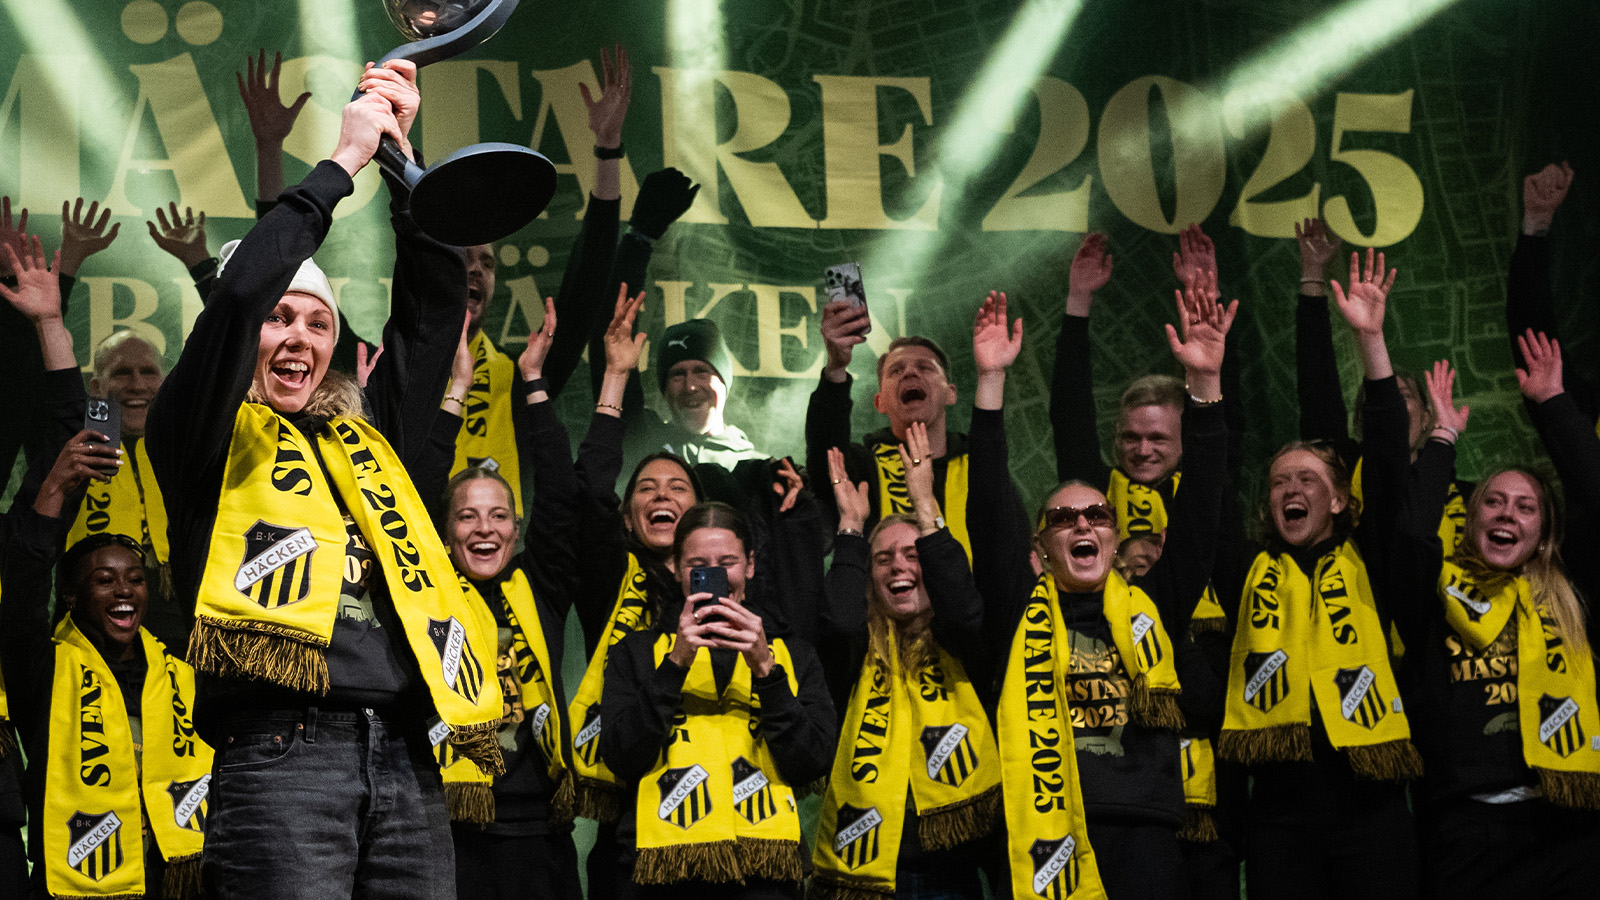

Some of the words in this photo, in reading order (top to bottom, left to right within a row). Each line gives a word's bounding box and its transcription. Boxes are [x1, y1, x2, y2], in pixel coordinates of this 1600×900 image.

[981, 75, 1425, 248] 2025
[243, 536, 309, 581] HÄCKEN
[361, 483, 435, 593] 2025
[445, 626, 462, 676] HÄCKEN
[1248, 655, 1282, 694] HÄCKEN
[1344, 672, 1370, 711] HÄCKEN
[1070, 703, 1129, 728] 2025
[1542, 702, 1575, 736] HÄCKEN
[930, 729, 963, 770] HÄCKEN
[663, 770, 703, 812] HÄCKEN
[733, 773, 766, 800] HÄCKEN
[1029, 728, 1067, 814] 2025
[73, 818, 116, 859] HÄCKEN
[838, 814, 876, 845] HÄCKEN
[1037, 840, 1074, 885] HÄCKEN
